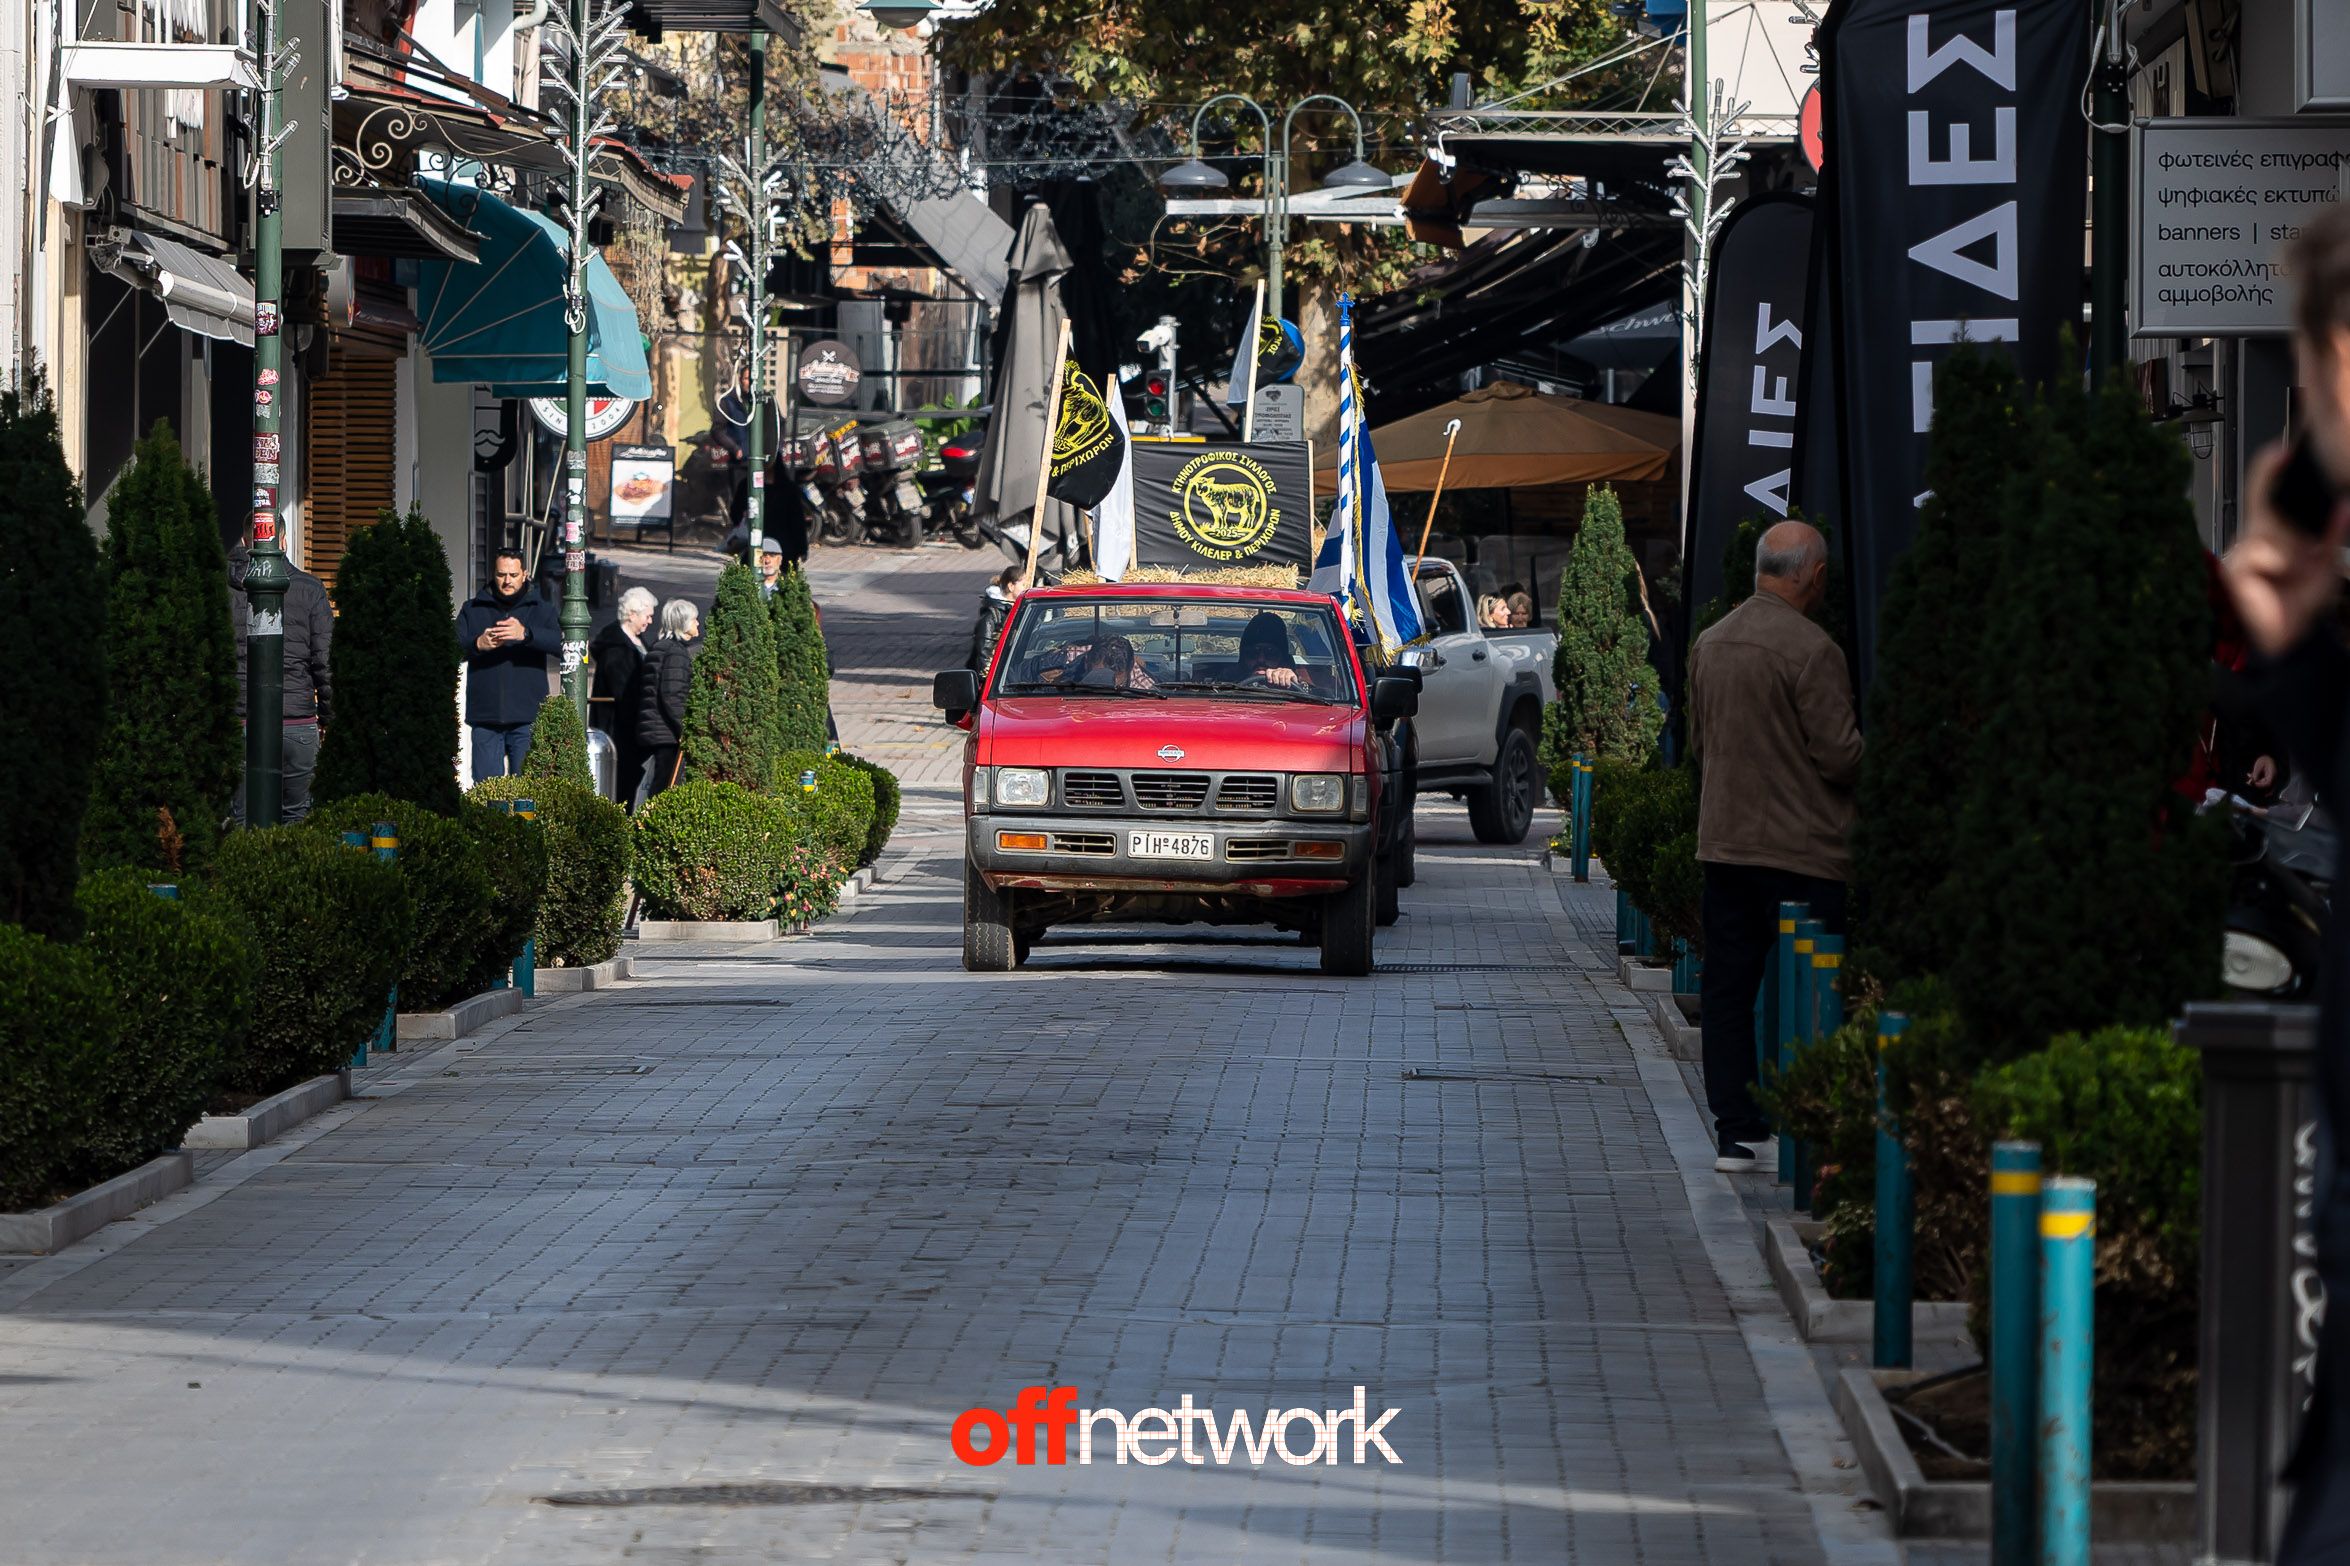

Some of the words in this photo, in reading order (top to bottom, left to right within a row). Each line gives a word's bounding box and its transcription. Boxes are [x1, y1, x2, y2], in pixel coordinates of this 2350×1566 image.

[2158, 150, 2254, 171] φωτεινές
[2260, 151, 2350, 171] επιγραφ
[2158, 185, 2257, 208] ψηφιακές
[2158, 223, 2241, 241] banners
[2158, 284, 2274, 306] αμμοβολής
[1171, 451, 1239, 494] ΚΤΗΝΟΤΡΟΦΙΚΟΣ
[1239, 454, 1278, 495] ΣΥΛΛΟΓΟΣ
[1169, 510, 1194, 544] ΔΗΜΟΥ
[1190, 539, 1233, 561] ΚΙΛΕΛΕΡ
[1235, 550, 1244, 559] &
[1244, 508, 1281, 557] ΠΕΡΙΧΩΡΩΝ
[1214, 528, 1239, 537] 2025
